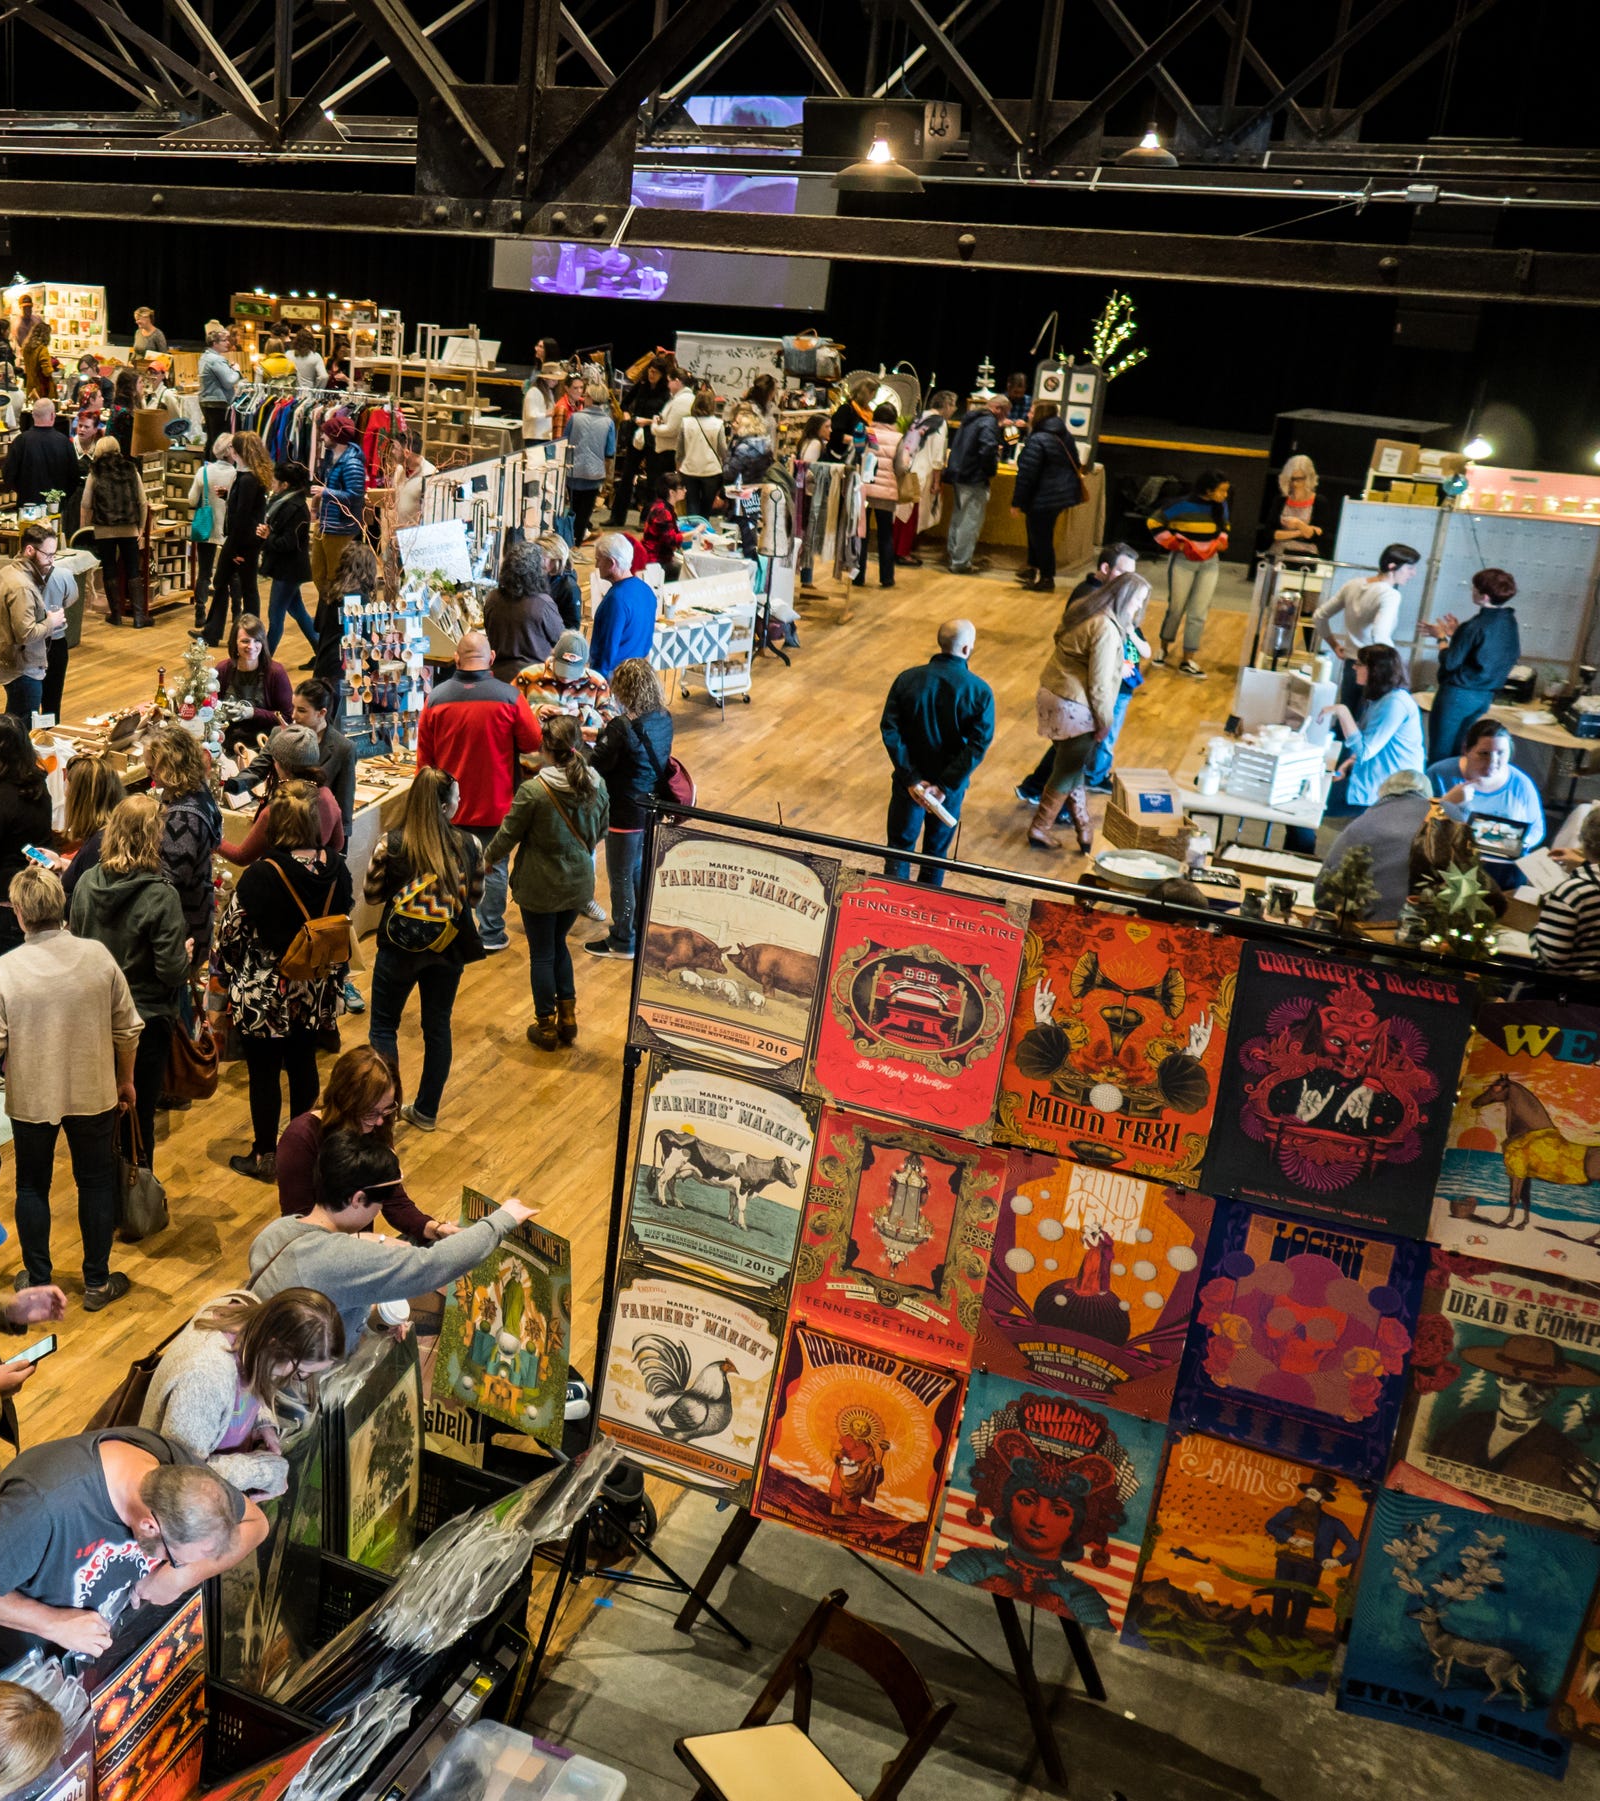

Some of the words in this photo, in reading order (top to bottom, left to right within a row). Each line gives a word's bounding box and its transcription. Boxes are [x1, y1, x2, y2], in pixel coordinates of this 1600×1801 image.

[709, 862, 744, 873] MARKET
[746, 869, 780, 883] SQUARE
[658, 869, 744, 891] FARMERS'
[750, 878, 825, 921] MARKET
[848, 896, 939, 924] TENNESSEE
[946, 917, 1018, 941] THEATRE
[669, 1021, 706, 1035] THROUGH
[707, 1030, 750, 1046] NOVEMBER
[756, 1039, 788, 1056] 2016
[1503, 1024, 1599, 1065] WE
[856, 1060, 874, 1071] The
[699, 1091, 733, 1102] MARKET
[735, 1099, 768, 1114] SQUARE
[652, 1095, 733, 1119] FARMERS'
[737, 1109, 811, 1151] MARKET
[1027, 1090, 1105, 1134] MOON
[1115, 1117, 1181, 1153] TAXI
[744, 1258, 775, 1276] 2015
[666, 1300, 699, 1313] MARKET
[701, 1310, 733, 1325] SQUARE
[880, 1289, 897, 1301] 90
[1489, 1281, 1600, 1316] WANTE
[620, 1303, 699, 1328] FARMERS'
[703, 1318, 774, 1361] MARKET
[805, 1296, 891, 1328] TENNESSEE
[898, 1324, 965, 1350] THEATRE
[1449, 1290, 1509, 1325] DEAD
[1514, 1309, 1530, 1329] &
[1535, 1313, 1600, 1347] COMP
[800, 1330, 897, 1377] WIDESPREAD
[897, 1364, 957, 1407] PANIC
[425, 1404, 468, 1447] sbell
[1024, 1403, 1101, 1438] CHILDISH
[1025, 1420, 1096, 1448] GAMBINO
[708, 1461, 738, 1477] 2014
[1181, 1436, 1217, 1457] DAVE
[1222, 1444, 1302, 1486] MATTHEWS
[1208, 1459, 1266, 1495] BAND
